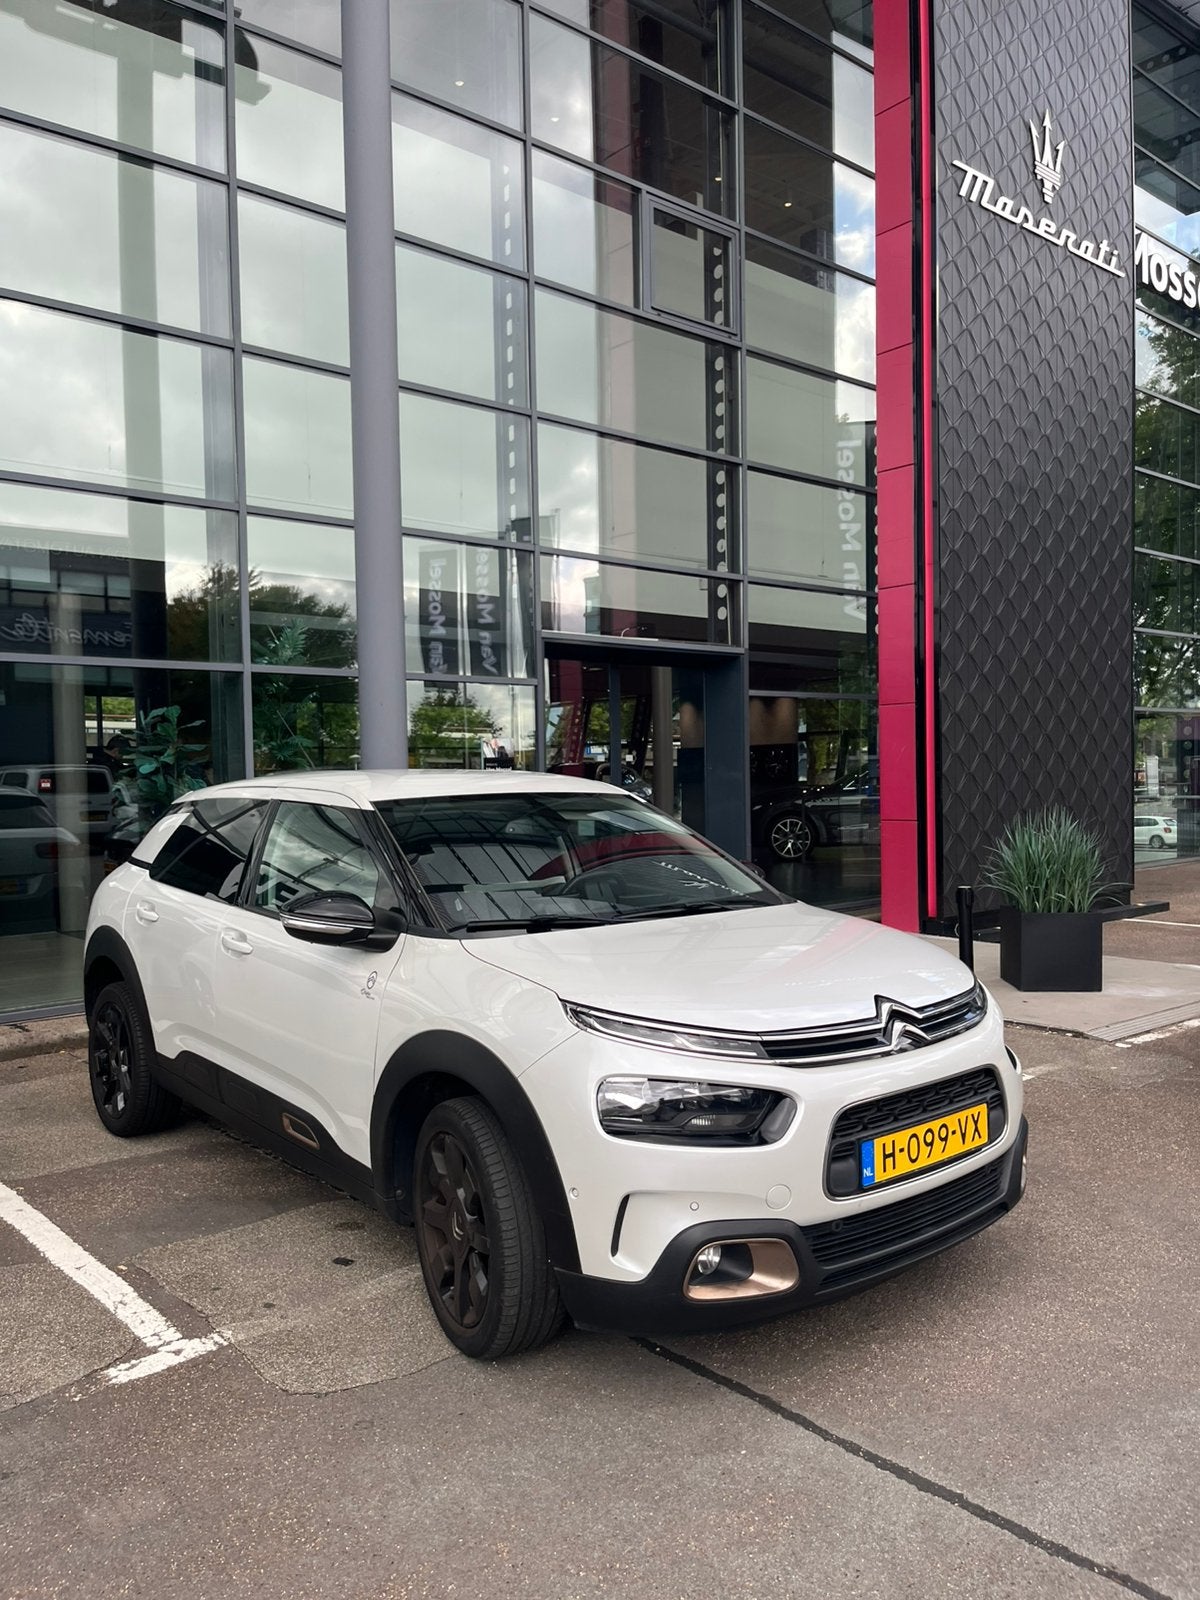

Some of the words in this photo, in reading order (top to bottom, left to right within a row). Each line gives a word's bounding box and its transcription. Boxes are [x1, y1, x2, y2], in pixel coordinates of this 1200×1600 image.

[952, 160, 1126, 278] Maserati
[1135, 231, 1200, 309] MOSS
[863, 1167, 874, 1177] NL
[882, 1111, 982, 1173] H-099-VX
